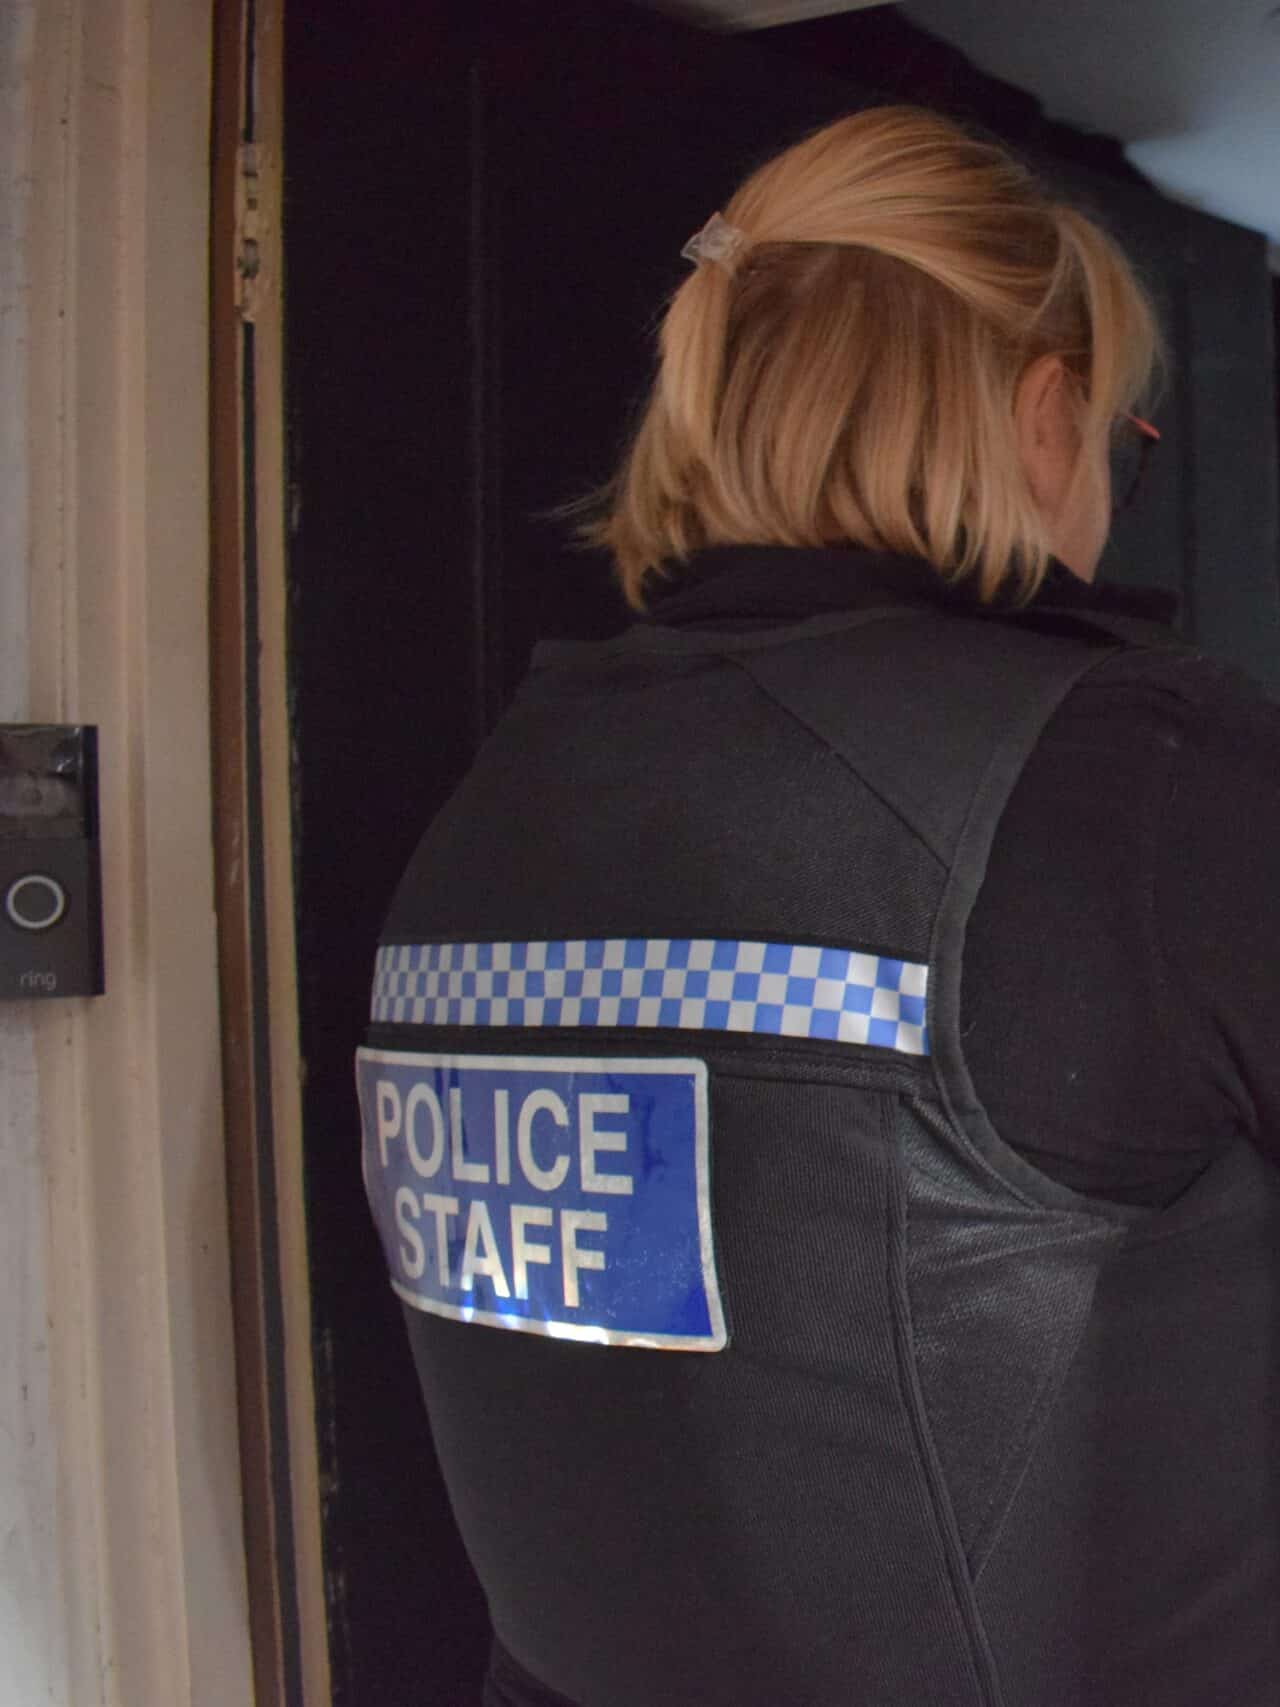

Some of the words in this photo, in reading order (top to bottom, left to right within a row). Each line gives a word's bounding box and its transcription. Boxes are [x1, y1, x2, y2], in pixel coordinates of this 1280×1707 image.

[20, 969, 57, 992] ring
[375, 1080, 634, 1195] POLICE
[394, 1186, 609, 1309] STAFF
